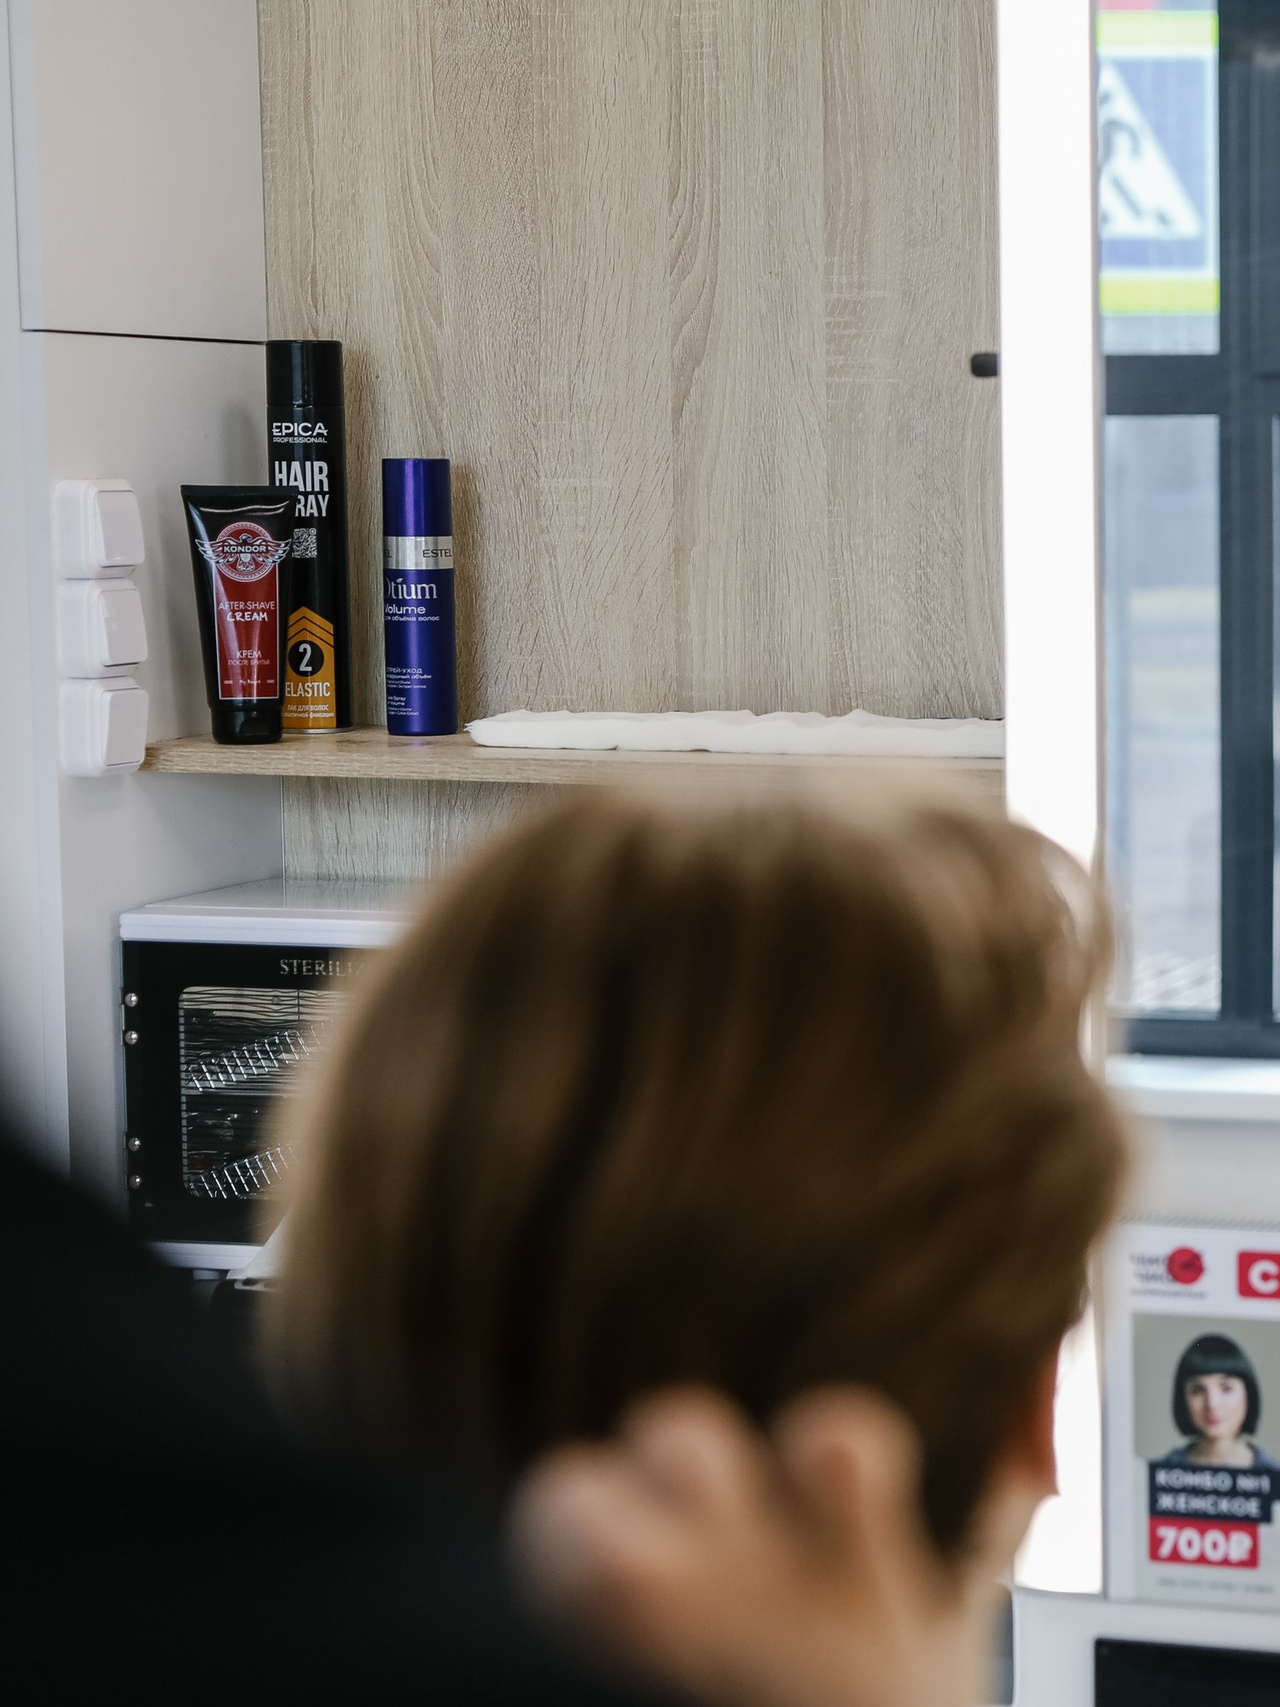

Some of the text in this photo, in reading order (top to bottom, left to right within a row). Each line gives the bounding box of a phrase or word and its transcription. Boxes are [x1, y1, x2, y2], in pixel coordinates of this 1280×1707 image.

[272, 422, 329, 437] EPICA
[272, 436, 328, 444] PROFESSIONAL
[274, 460, 329, 492] HAIR
[294, 494, 330, 518] RAY
[223, 544, 267, 553] KONDOR
[422, 548, 453, 558] ESTEL
[218, 601, 276, 611] AFTER-SHAVE
[226, 611, 268, 622] CREAM
[227, 658, 249, 666] ПОСЛЕ
[236, 650, 263, 659] КРЕМ
[298, 643, 313, 672] 2
[285, 681, 331, 698] ELASTIC
[1247, 1259, 1280, 1295] С
[1154, 1467, 1234, 1492] КОМБО
[1156, 1491, 1262, 1519] ЖЕНСКОЕ
